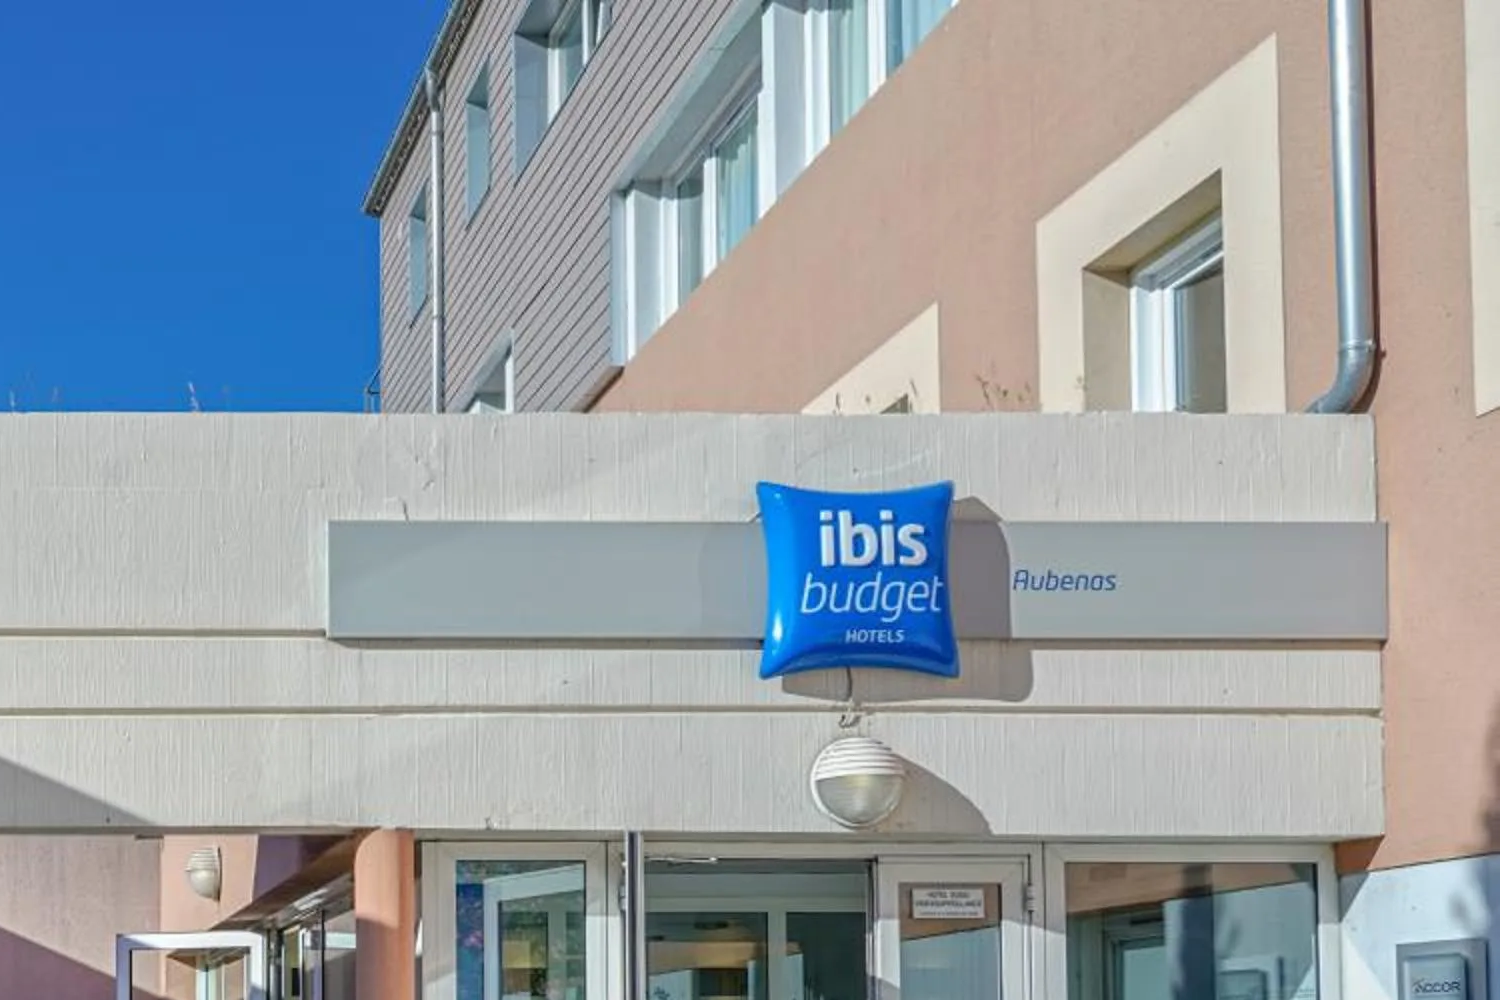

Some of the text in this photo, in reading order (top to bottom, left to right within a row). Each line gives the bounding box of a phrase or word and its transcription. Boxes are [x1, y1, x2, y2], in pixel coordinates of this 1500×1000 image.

[819, 509, 928, 567] ibis
[801, 571, 943, 623] budget
[1013, 568, 1117, 591] Aubenas
[845, 629, 905, 644] HOTELS
